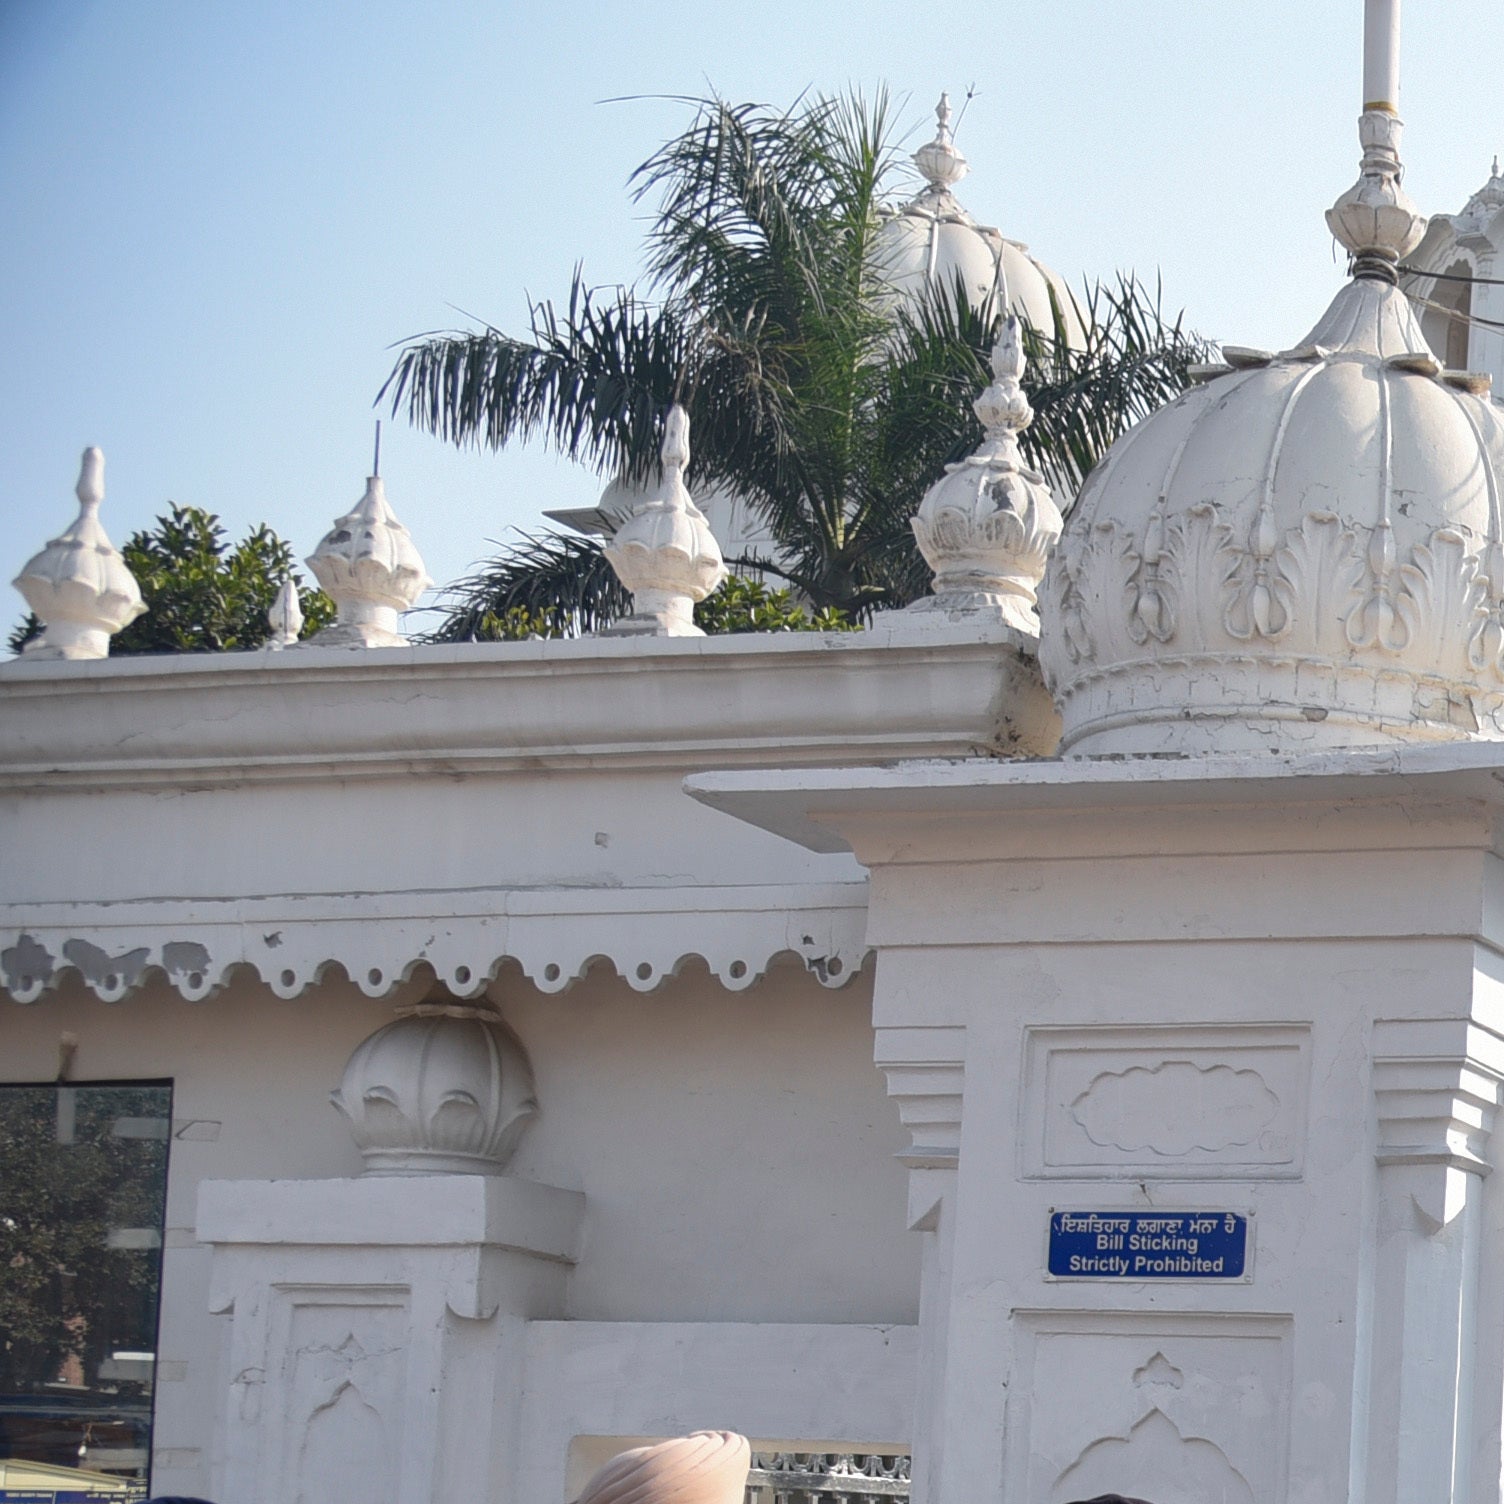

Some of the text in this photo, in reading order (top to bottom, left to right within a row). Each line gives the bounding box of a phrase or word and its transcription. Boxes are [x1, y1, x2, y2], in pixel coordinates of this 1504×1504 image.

[1136, 1219, 1183, 1233] ਲਗਾਣਾ
[1224, 1213, 1236, 1234] ਹੈ
[1096, 1234, 1198, 1254] Bill Sticking
[1069, 1255, 1223, 1275] Strictly Prohibited
